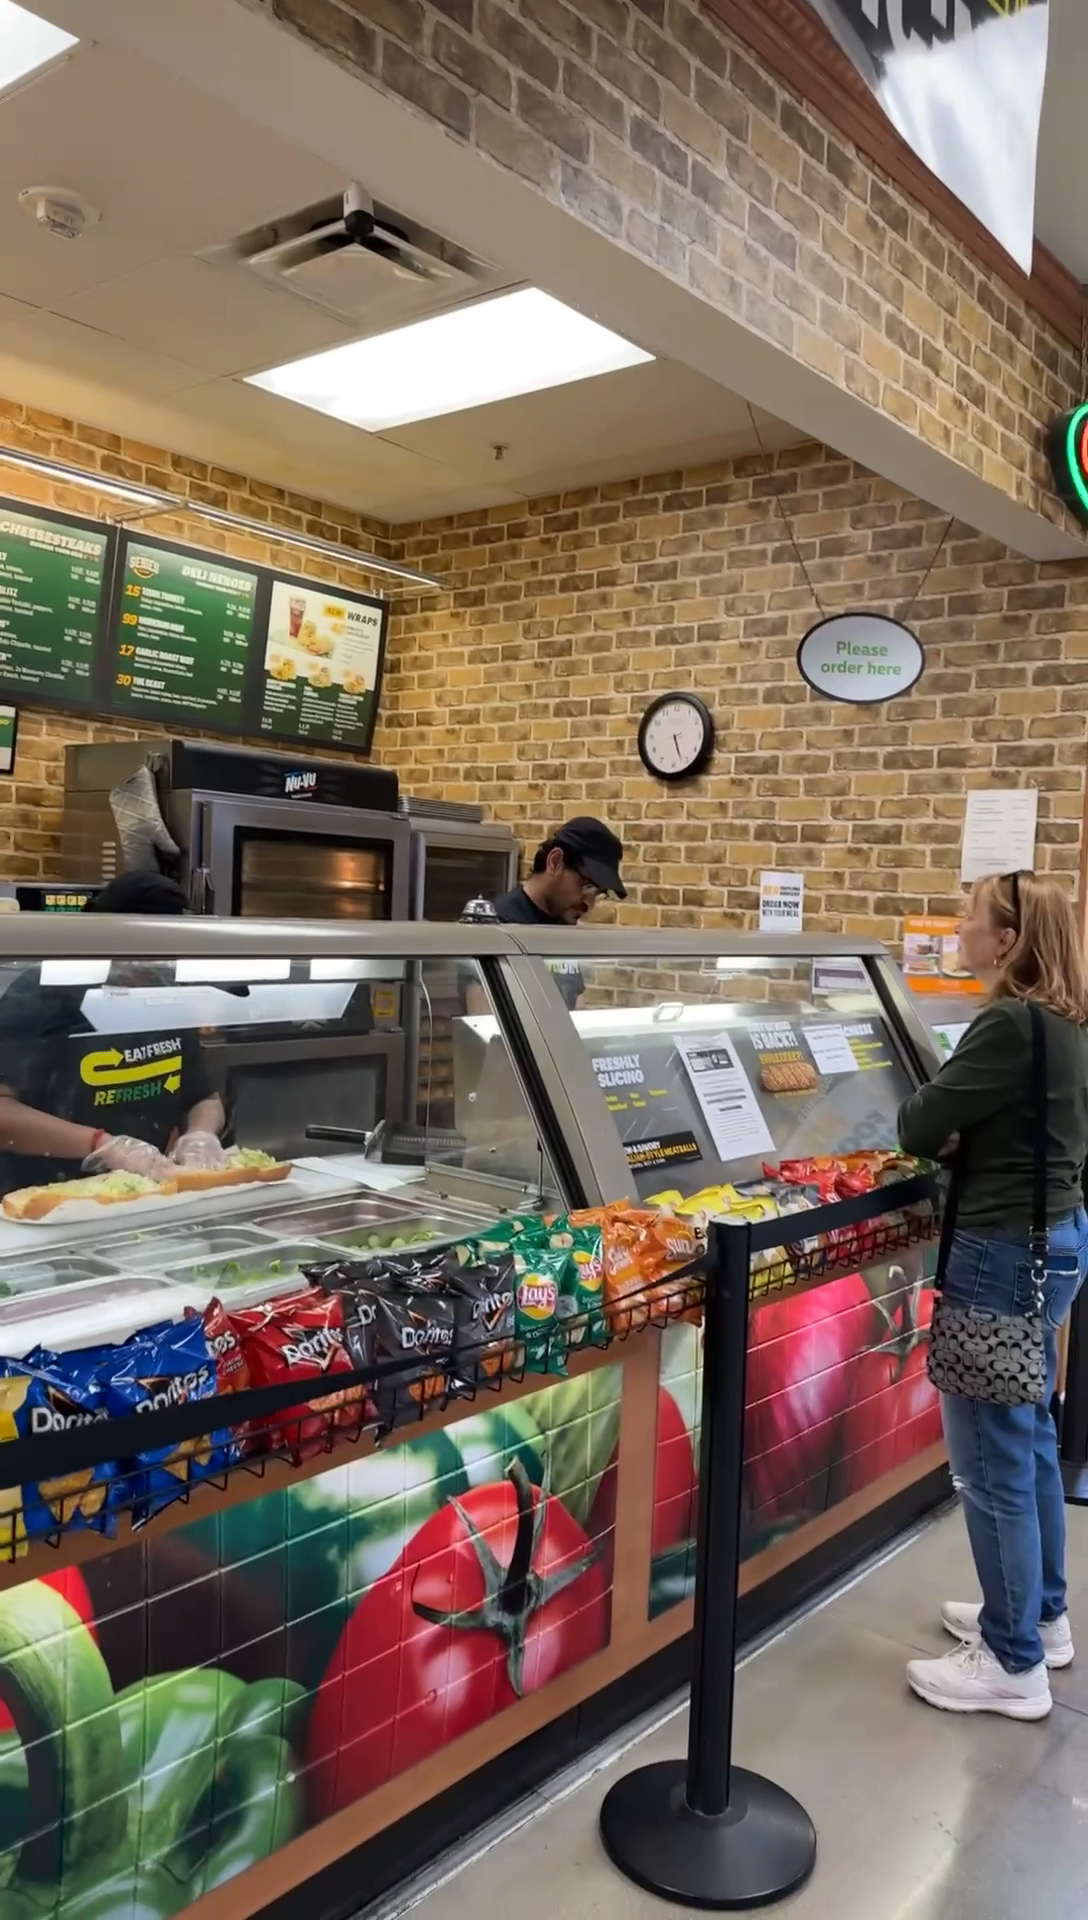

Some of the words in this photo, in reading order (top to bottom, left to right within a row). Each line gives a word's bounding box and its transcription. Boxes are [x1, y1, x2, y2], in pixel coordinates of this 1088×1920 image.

[0, 520, 102, 556] CHEESESTEAKS
[181, 565, 208, 580] DELI
[125, 584, 141, 597] 15
[122, 613, 138, 625] 99
[347, 611, 379, 628] WRAPS
[119, 644, 135, 656] 17
[836, 641, 889, 657] Please
[821, 660, 863, 675] order
[867, 661, 903, 676] here
[116, 674, 132, 686] 30
[285, 772, 317, 793] NU-VU
[762, 900, 781, 908] ORDER
[782, 900, 800, 909] NOW
[843, 1023, 874, 1036] CHEESE
[750, 1033, 764, 1050] IS
[591, 1054, 641, 1073] FRESHLY
[597, 1069, 645, 1088] SLICING
[93, 1080, 162, 1107] REFRESH
[664, 1142, 698, 1156] MEATBALLS
[280, 1327, 345, 1367] Doritos
